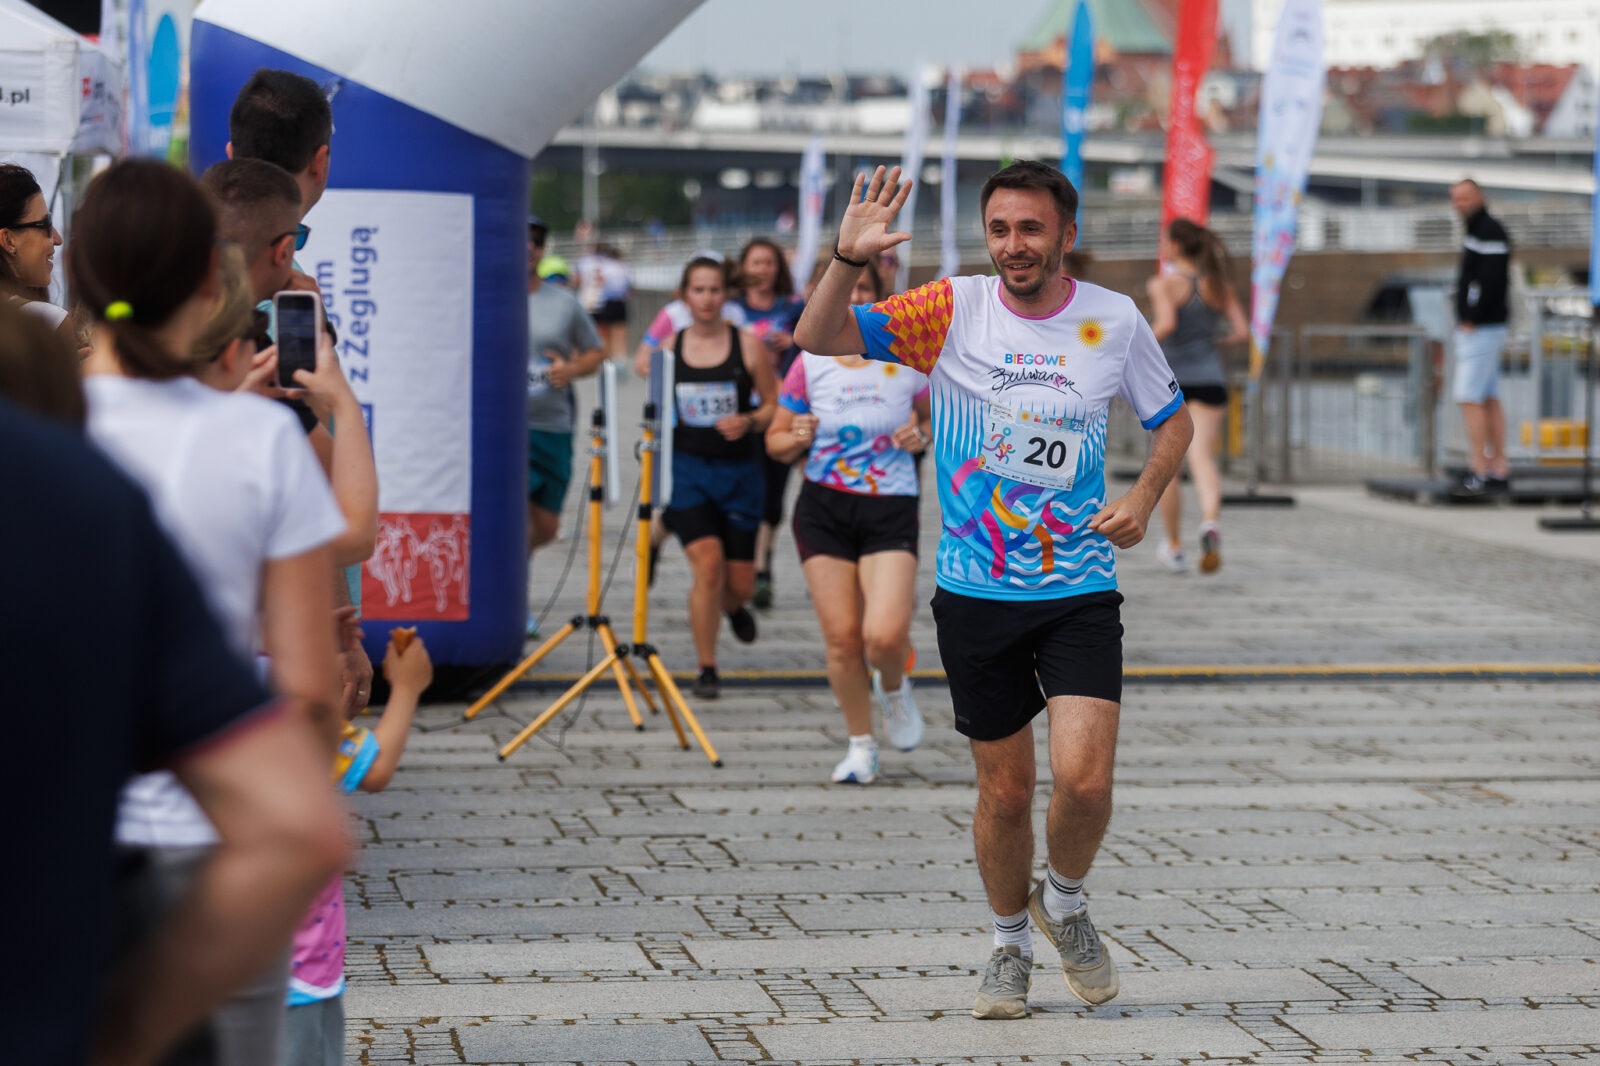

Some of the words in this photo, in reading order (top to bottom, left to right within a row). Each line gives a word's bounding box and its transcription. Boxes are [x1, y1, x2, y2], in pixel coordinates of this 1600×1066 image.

[0, 86, 30, 107] .pl
[339, 226, 378, 356] Żeglugą
[1004, 353, 1066, 366] BIEGOWE
[350, 366, 369, 384] z
[1023, 436, 1067, 468] 20
